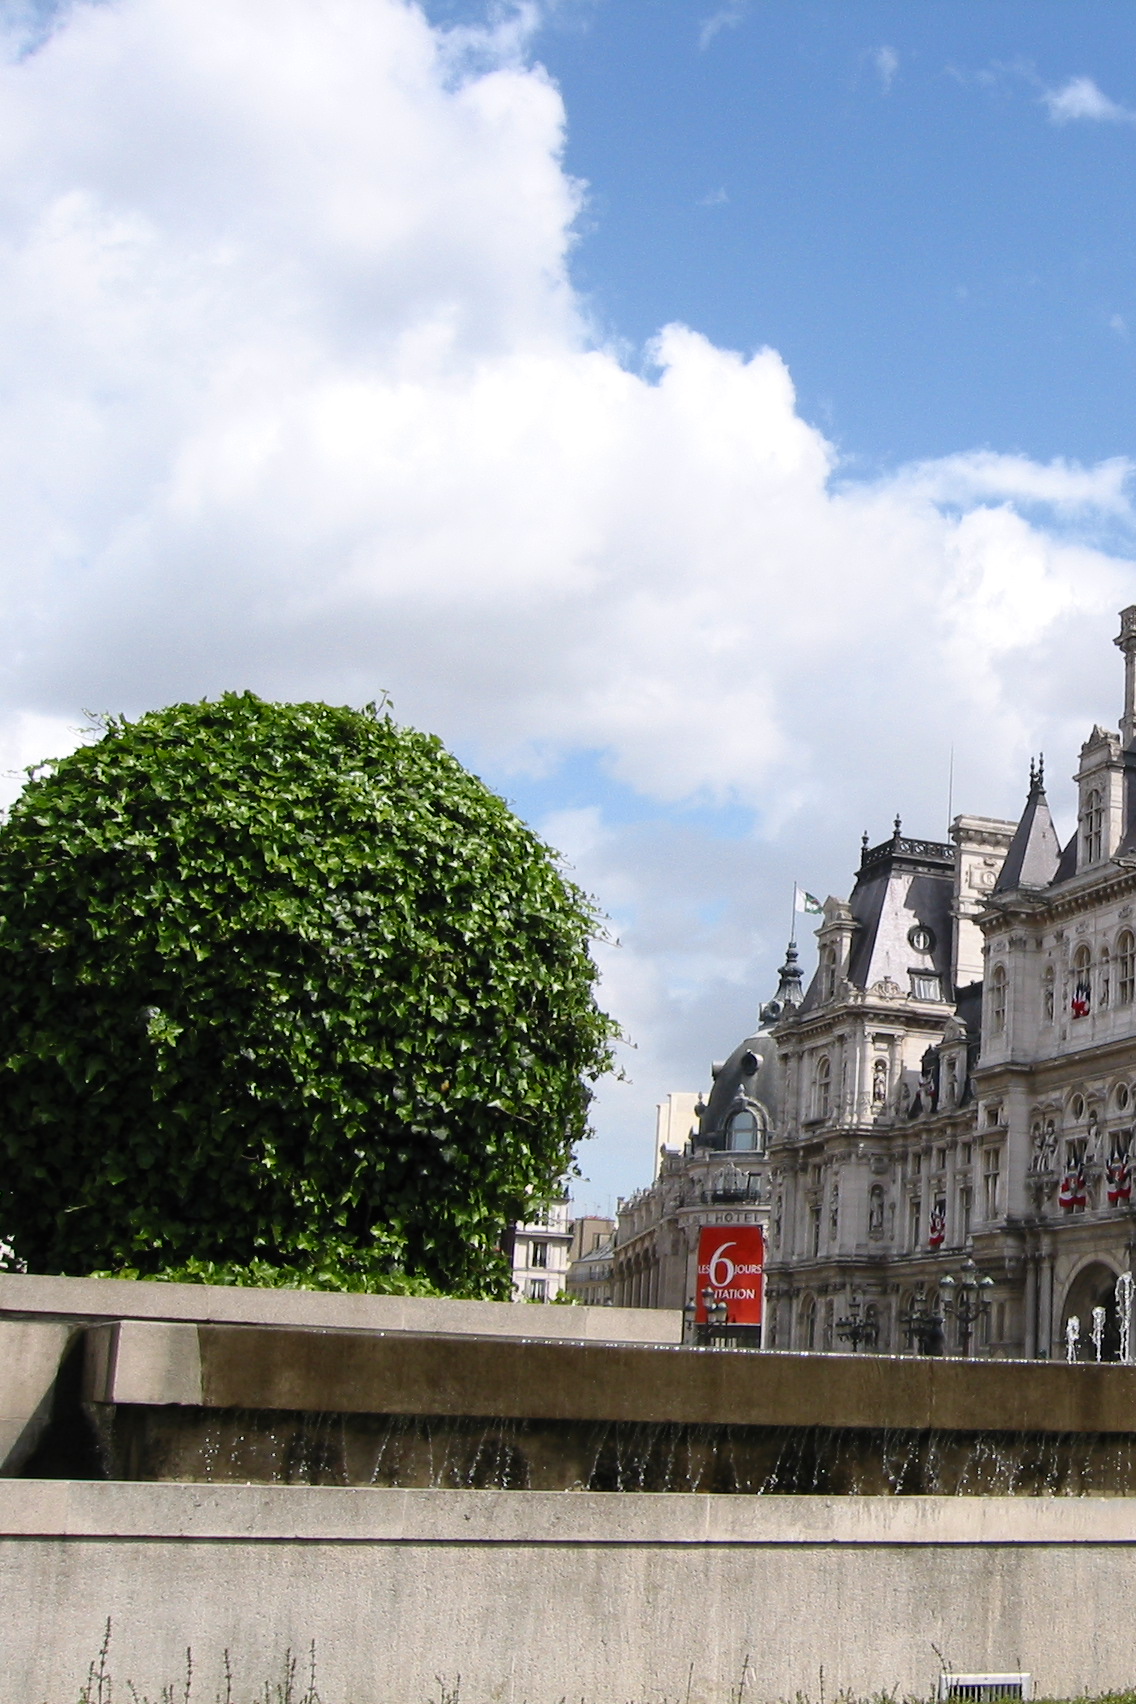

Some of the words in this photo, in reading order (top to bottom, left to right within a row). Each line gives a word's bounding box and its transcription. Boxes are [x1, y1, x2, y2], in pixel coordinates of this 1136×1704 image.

[698, 1264, 710, 1274] LES
[710, 1242, 737, 1287] 6
[734, 1264, 762, 1274] JOURS
